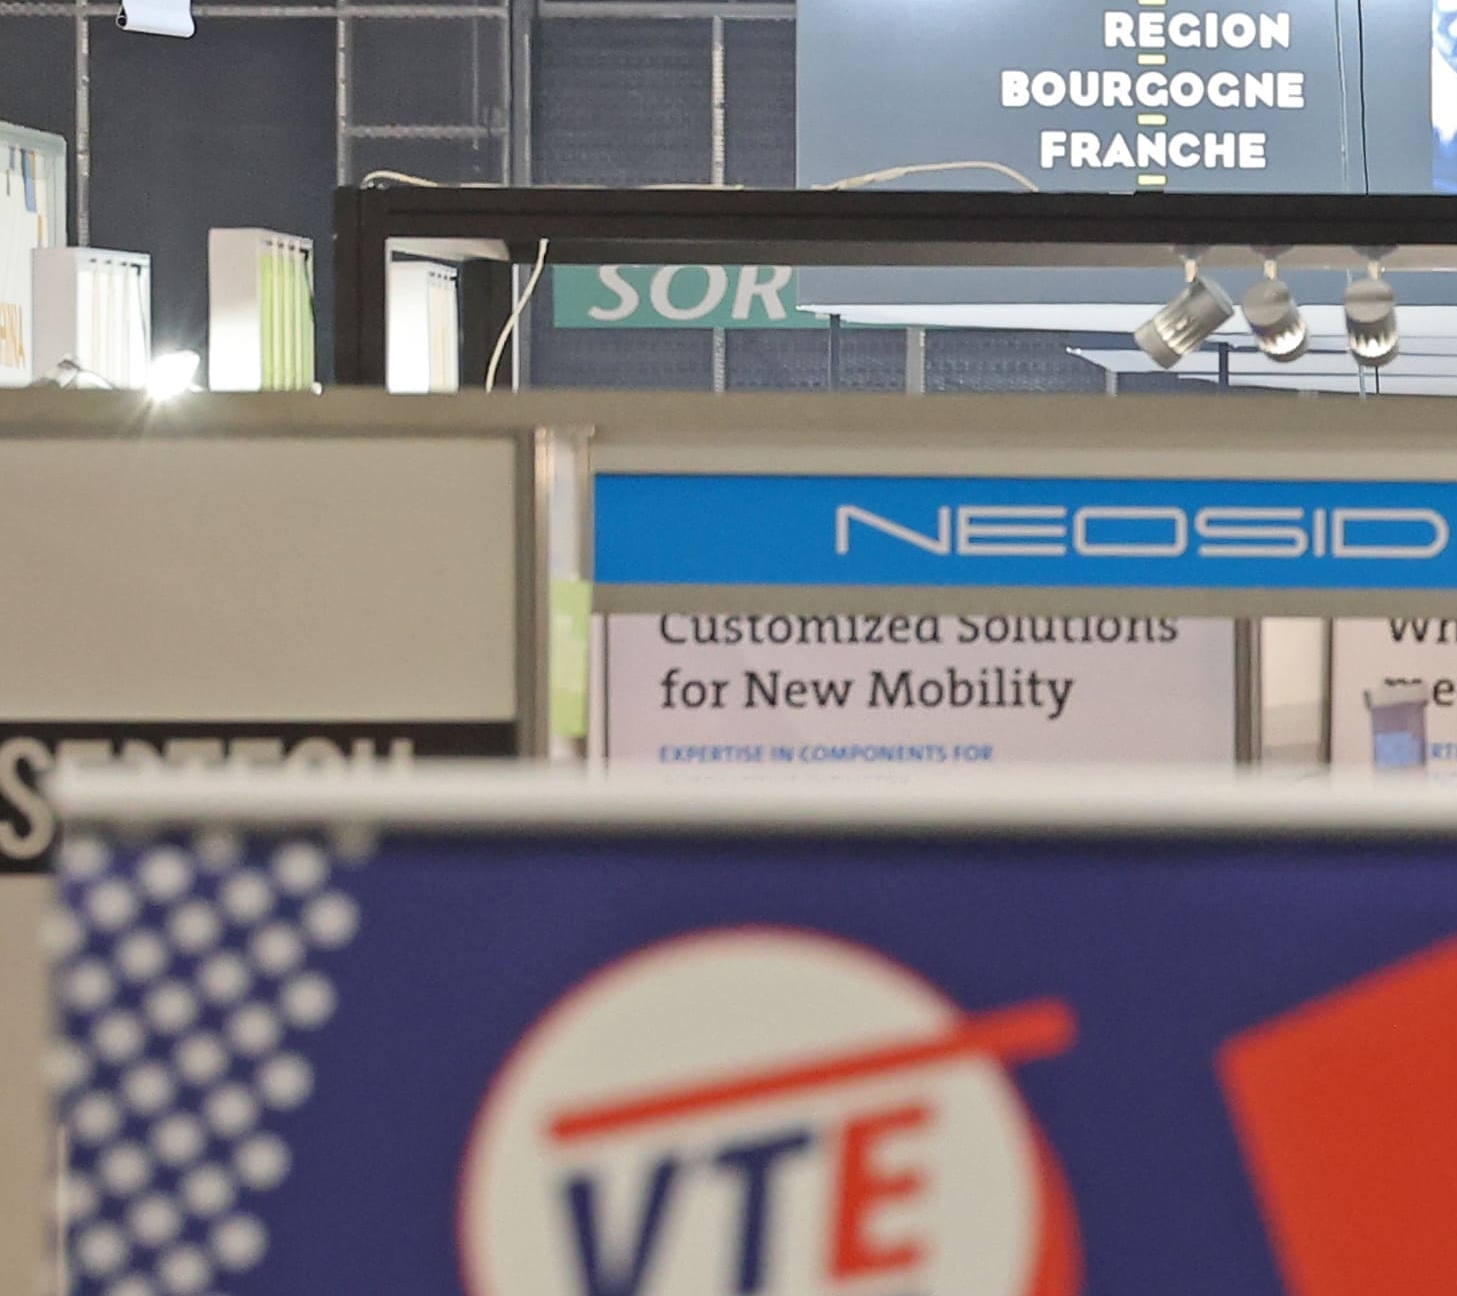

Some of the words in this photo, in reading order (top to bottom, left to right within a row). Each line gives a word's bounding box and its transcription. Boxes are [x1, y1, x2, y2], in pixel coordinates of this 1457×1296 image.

[1000, 71, 1305, 109] BOURGOGNE
[1039, 131, 1267, 169] FRANCHE
[836, 505, 1449, 559] NEOSID
[661, 667, 729, 708] for
[744, 669, 853, 709] New
[868, 667, 1075, 720] Mobility
[660, 746, 763, 763] EXPERTISE
[771, 746, 794, 763] IN
[801, 746, 947, 763] COMPONENTS
[954, 746, 993, 763] FOR
